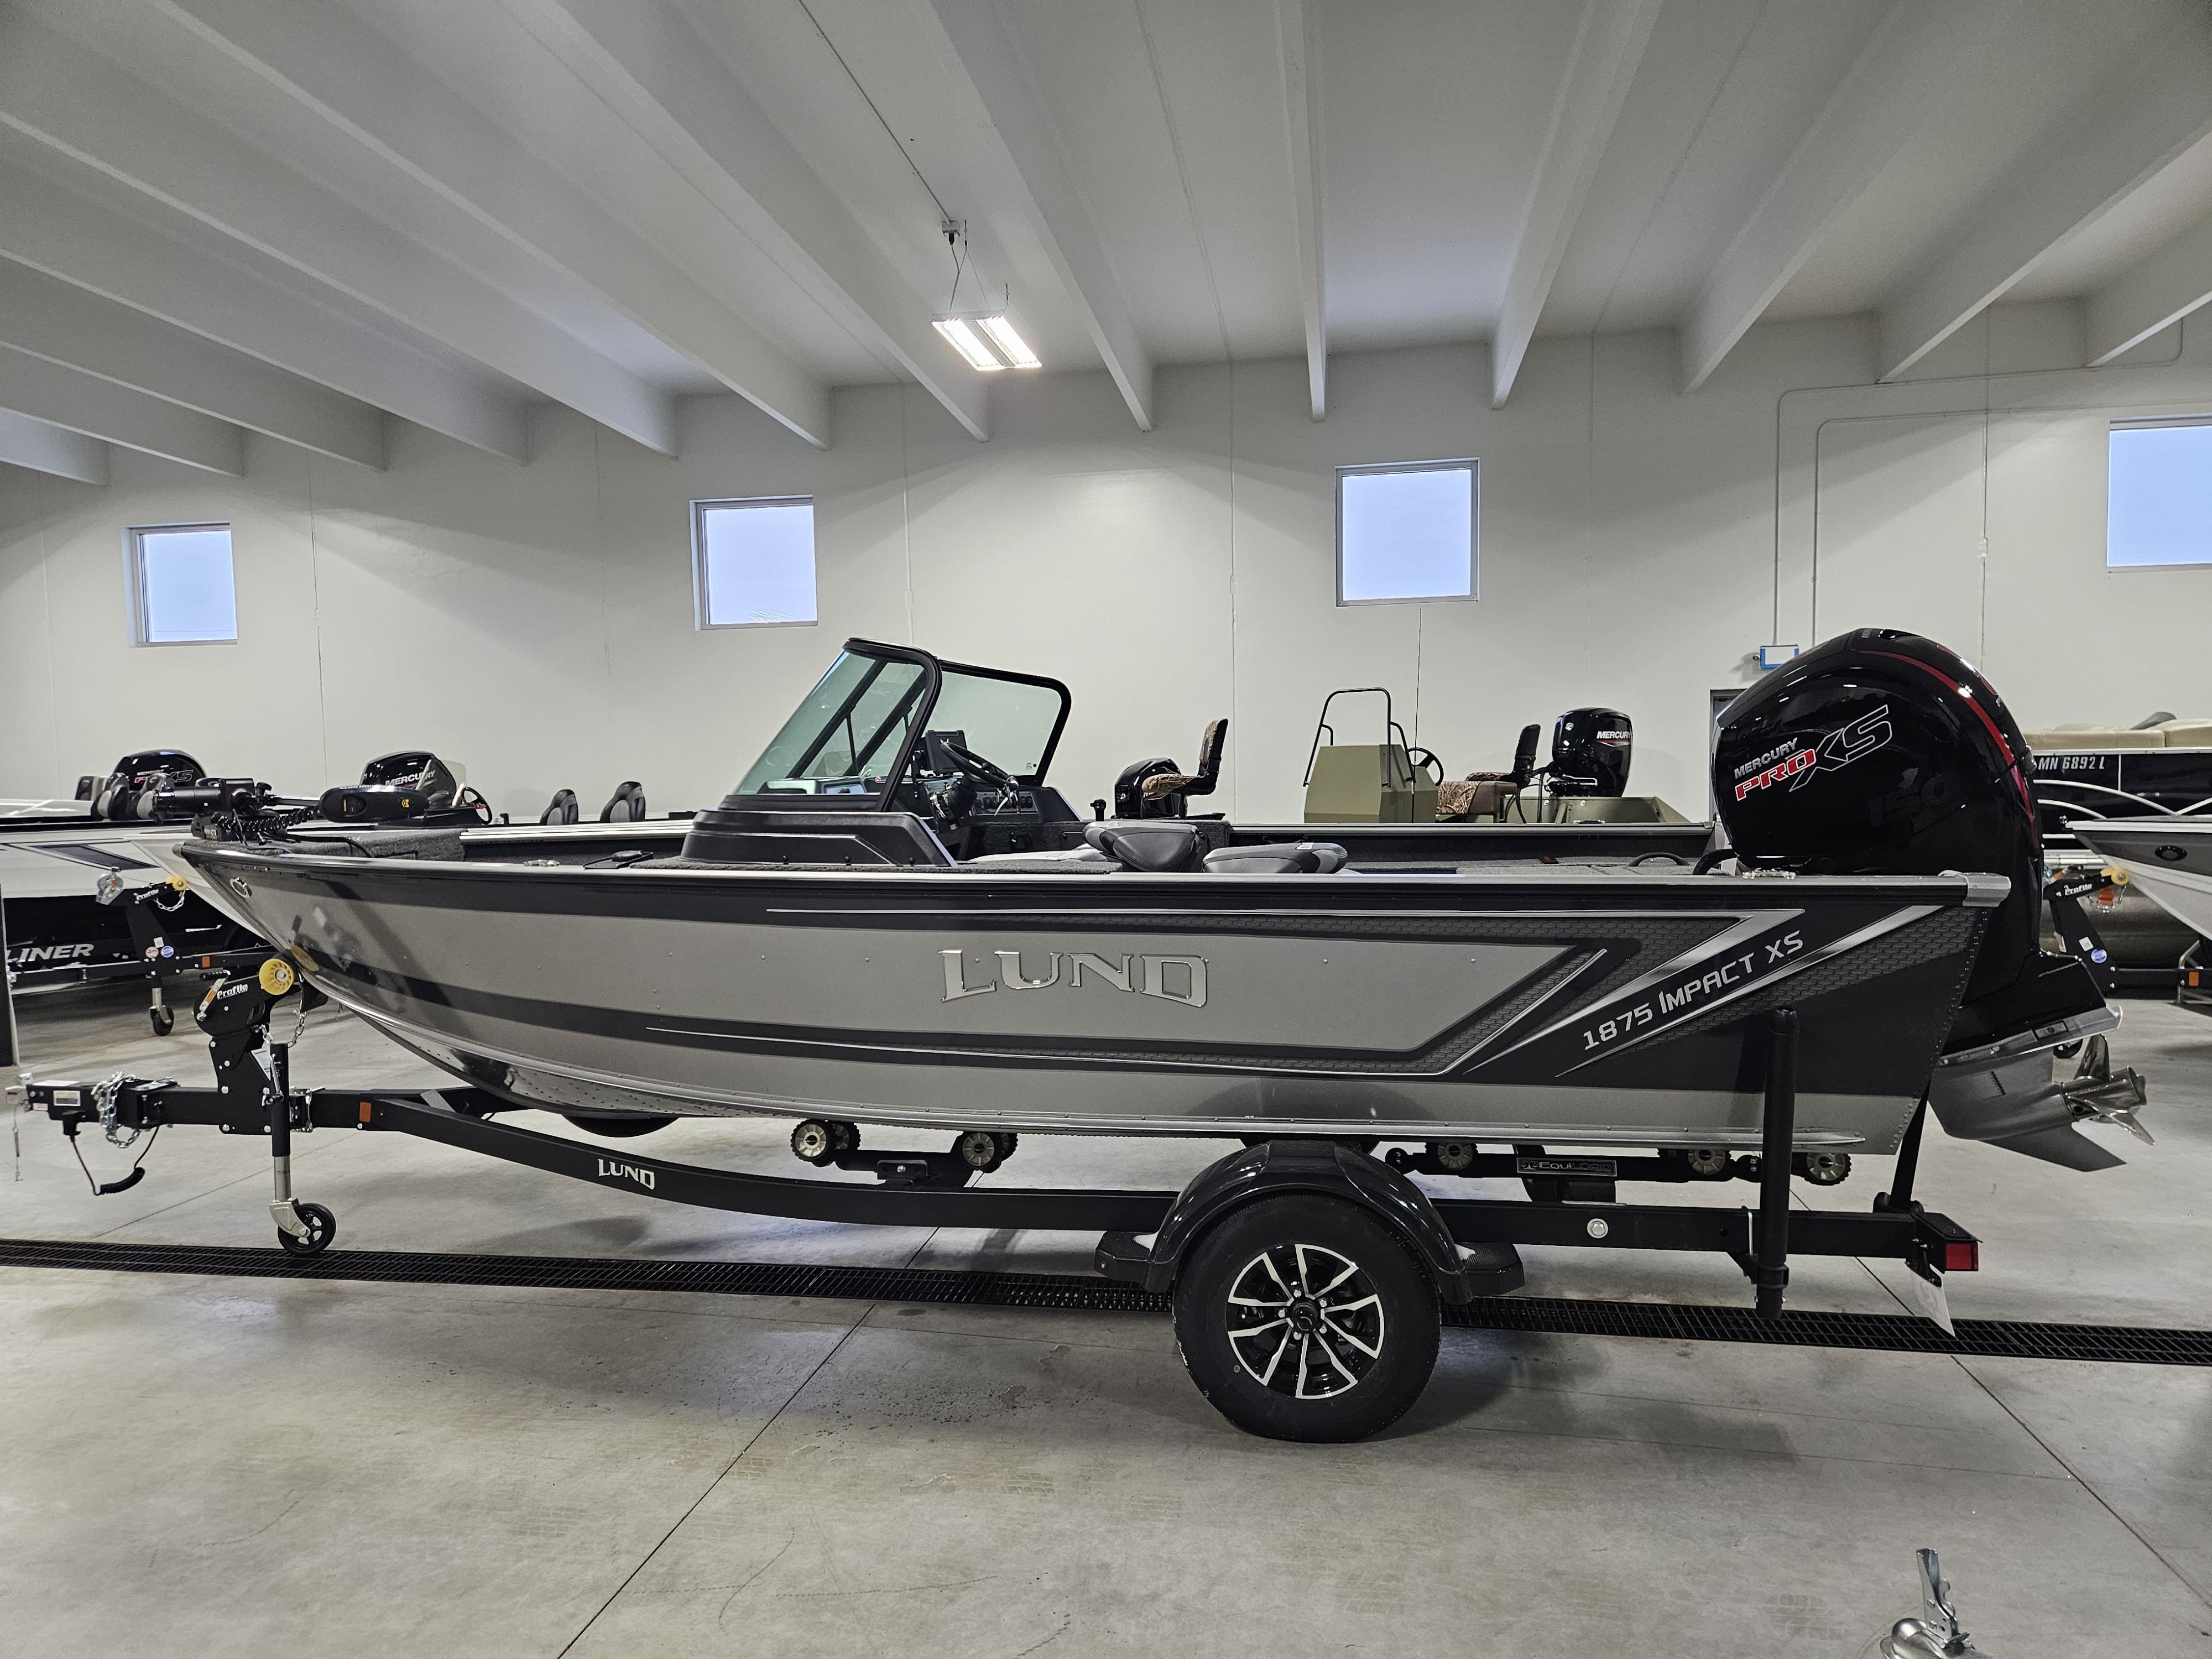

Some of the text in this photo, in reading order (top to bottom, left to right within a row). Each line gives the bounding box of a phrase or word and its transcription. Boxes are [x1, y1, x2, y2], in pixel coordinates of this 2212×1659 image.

[1734, 738, 1798, 779] MERCURY
[1735, 705, 1892, 801] PRO XS
[2038, 756, 2105, 770] MN 6892 L
[385, 770, 436, 786] MERCURY
[217, 984, 248, 999] Profile
[937, 950, 1208, 1008] LUND
[1583, 1002, 1653, 1051] 1875
[1765, 930, 1803, 964] XS
[598, 1159, 655, 1190] LUND
